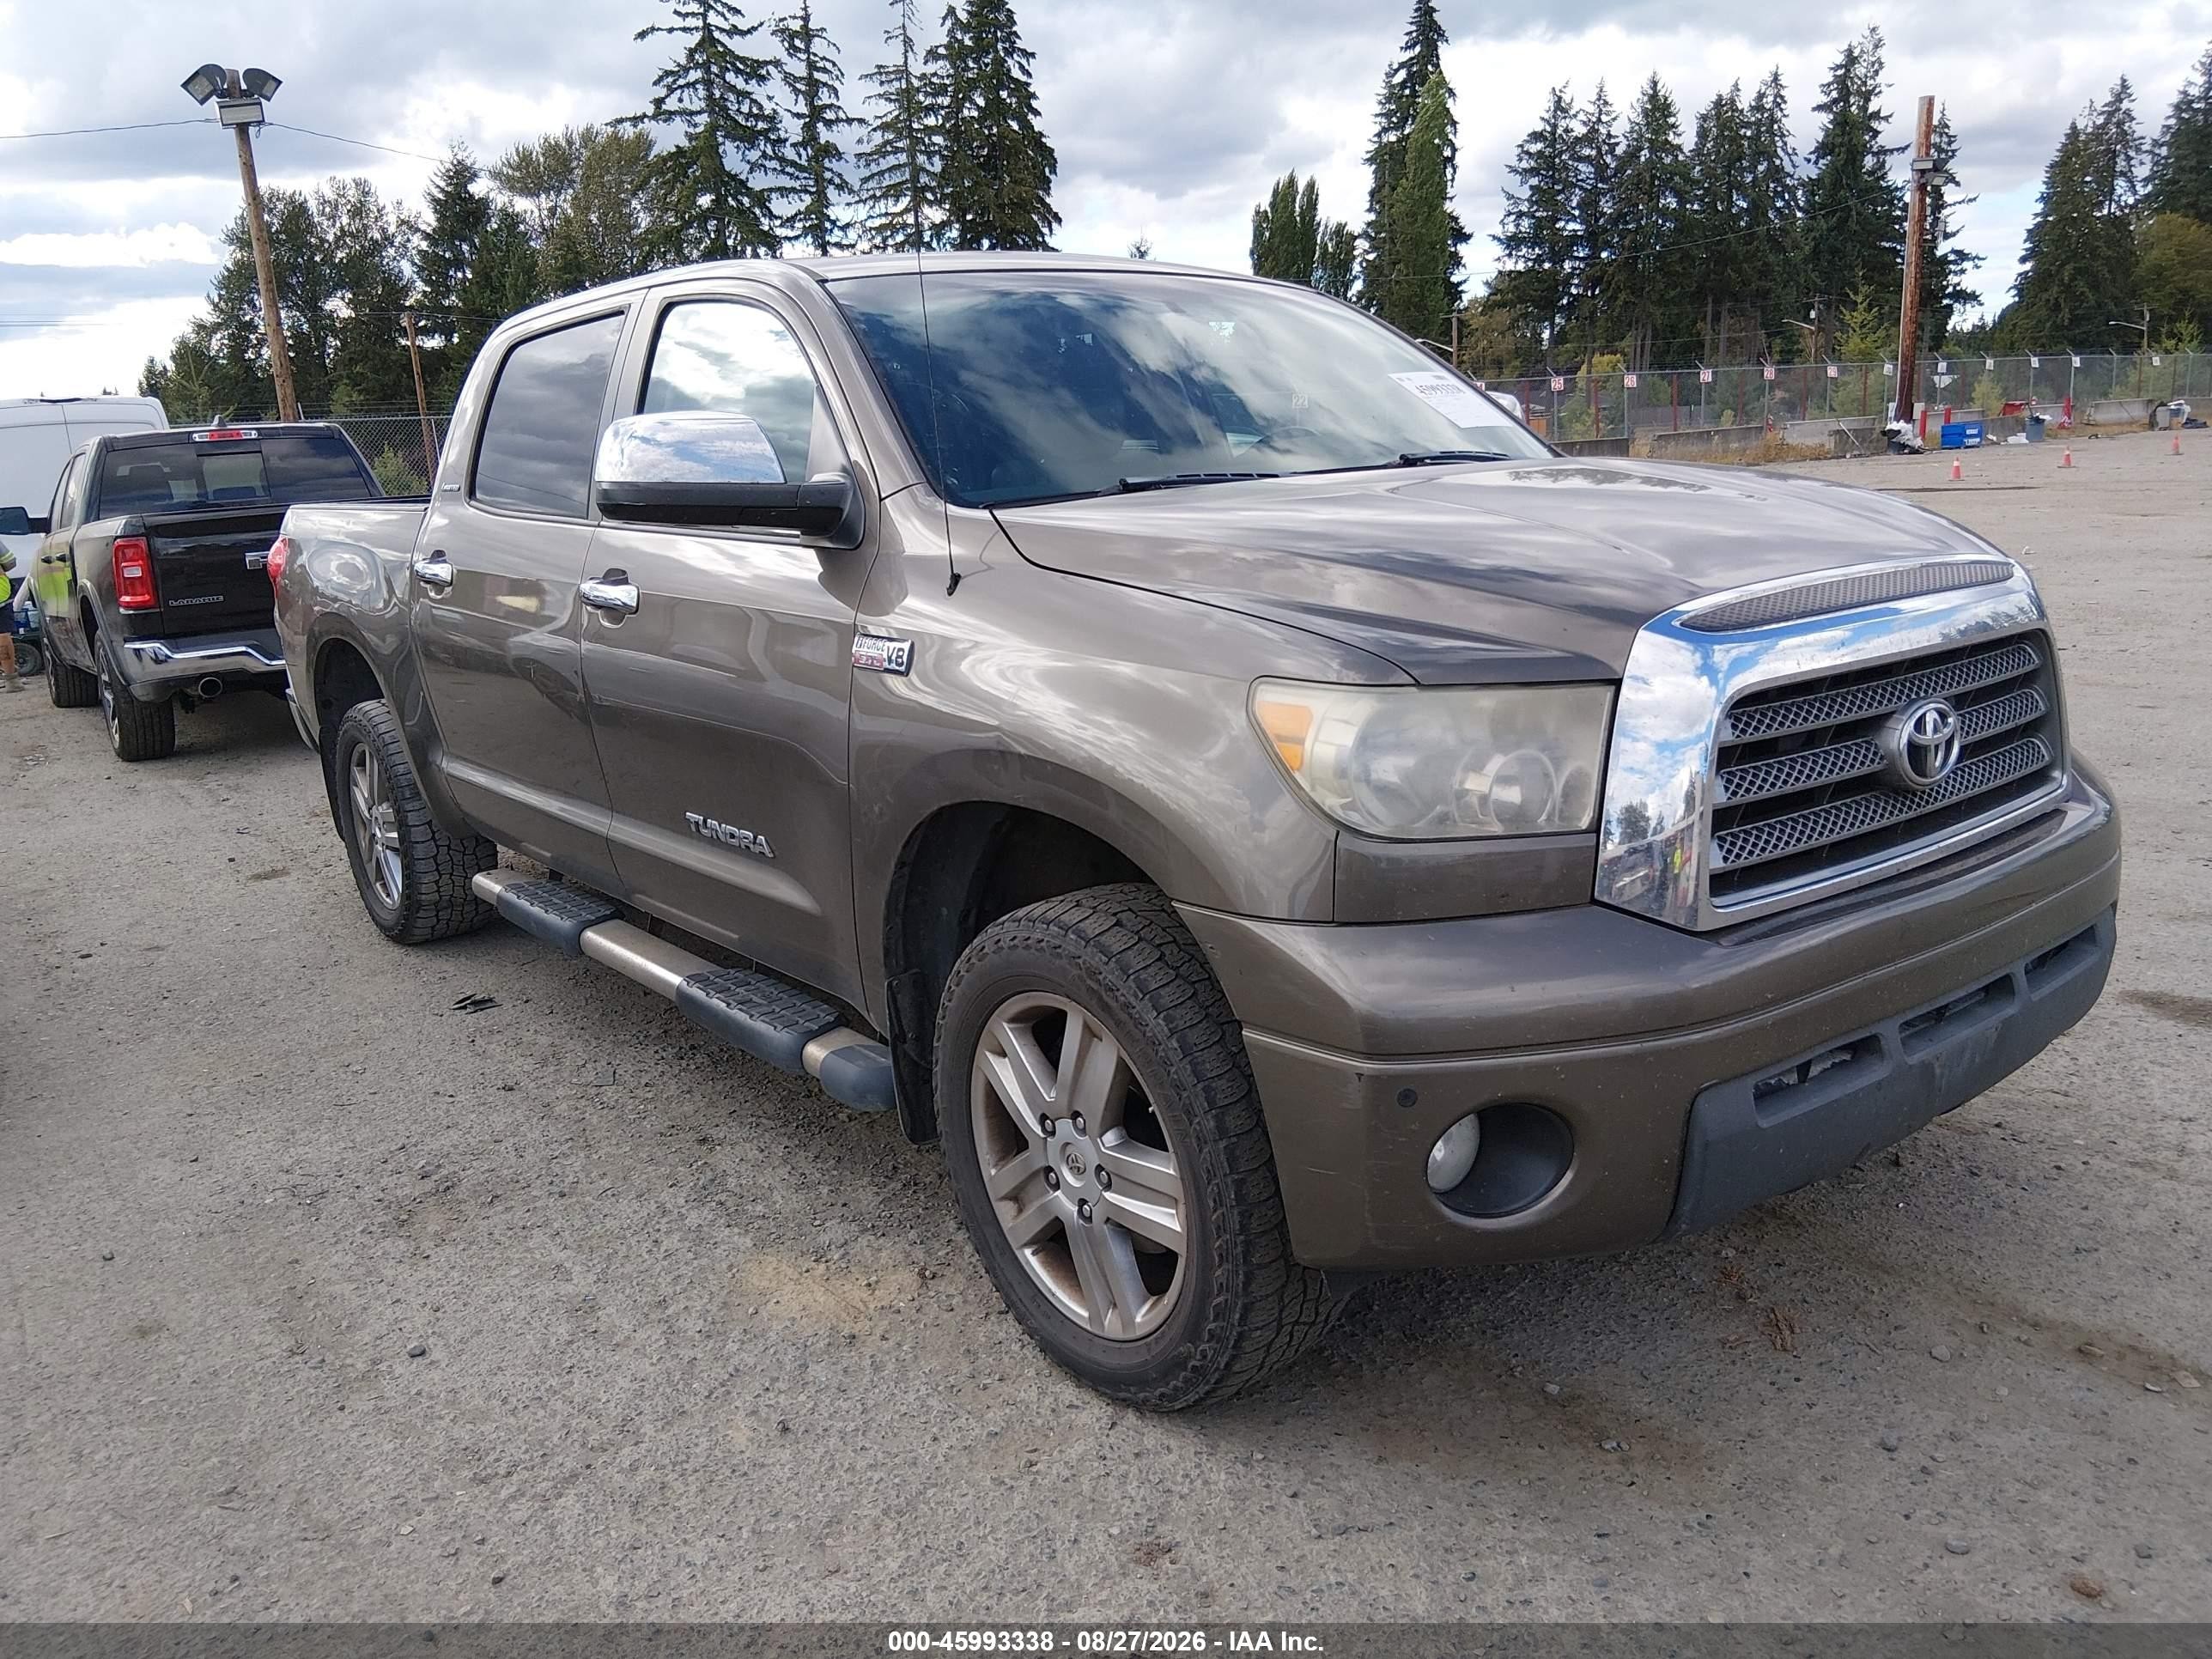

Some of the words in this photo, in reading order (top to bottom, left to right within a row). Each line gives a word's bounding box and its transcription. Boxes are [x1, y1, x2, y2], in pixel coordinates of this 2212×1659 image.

[1701, 371, 1711, 381] 27
[1765, 368, 1773, 379] 28
[1552, 378, 1563, 390] 25
[1625, 375, 1635, 386] 26
[168, 595, 224, 606] LARAMIE
[886, 645, 906, 668] V8
[685, 811, 775, 858] TUNDRA
